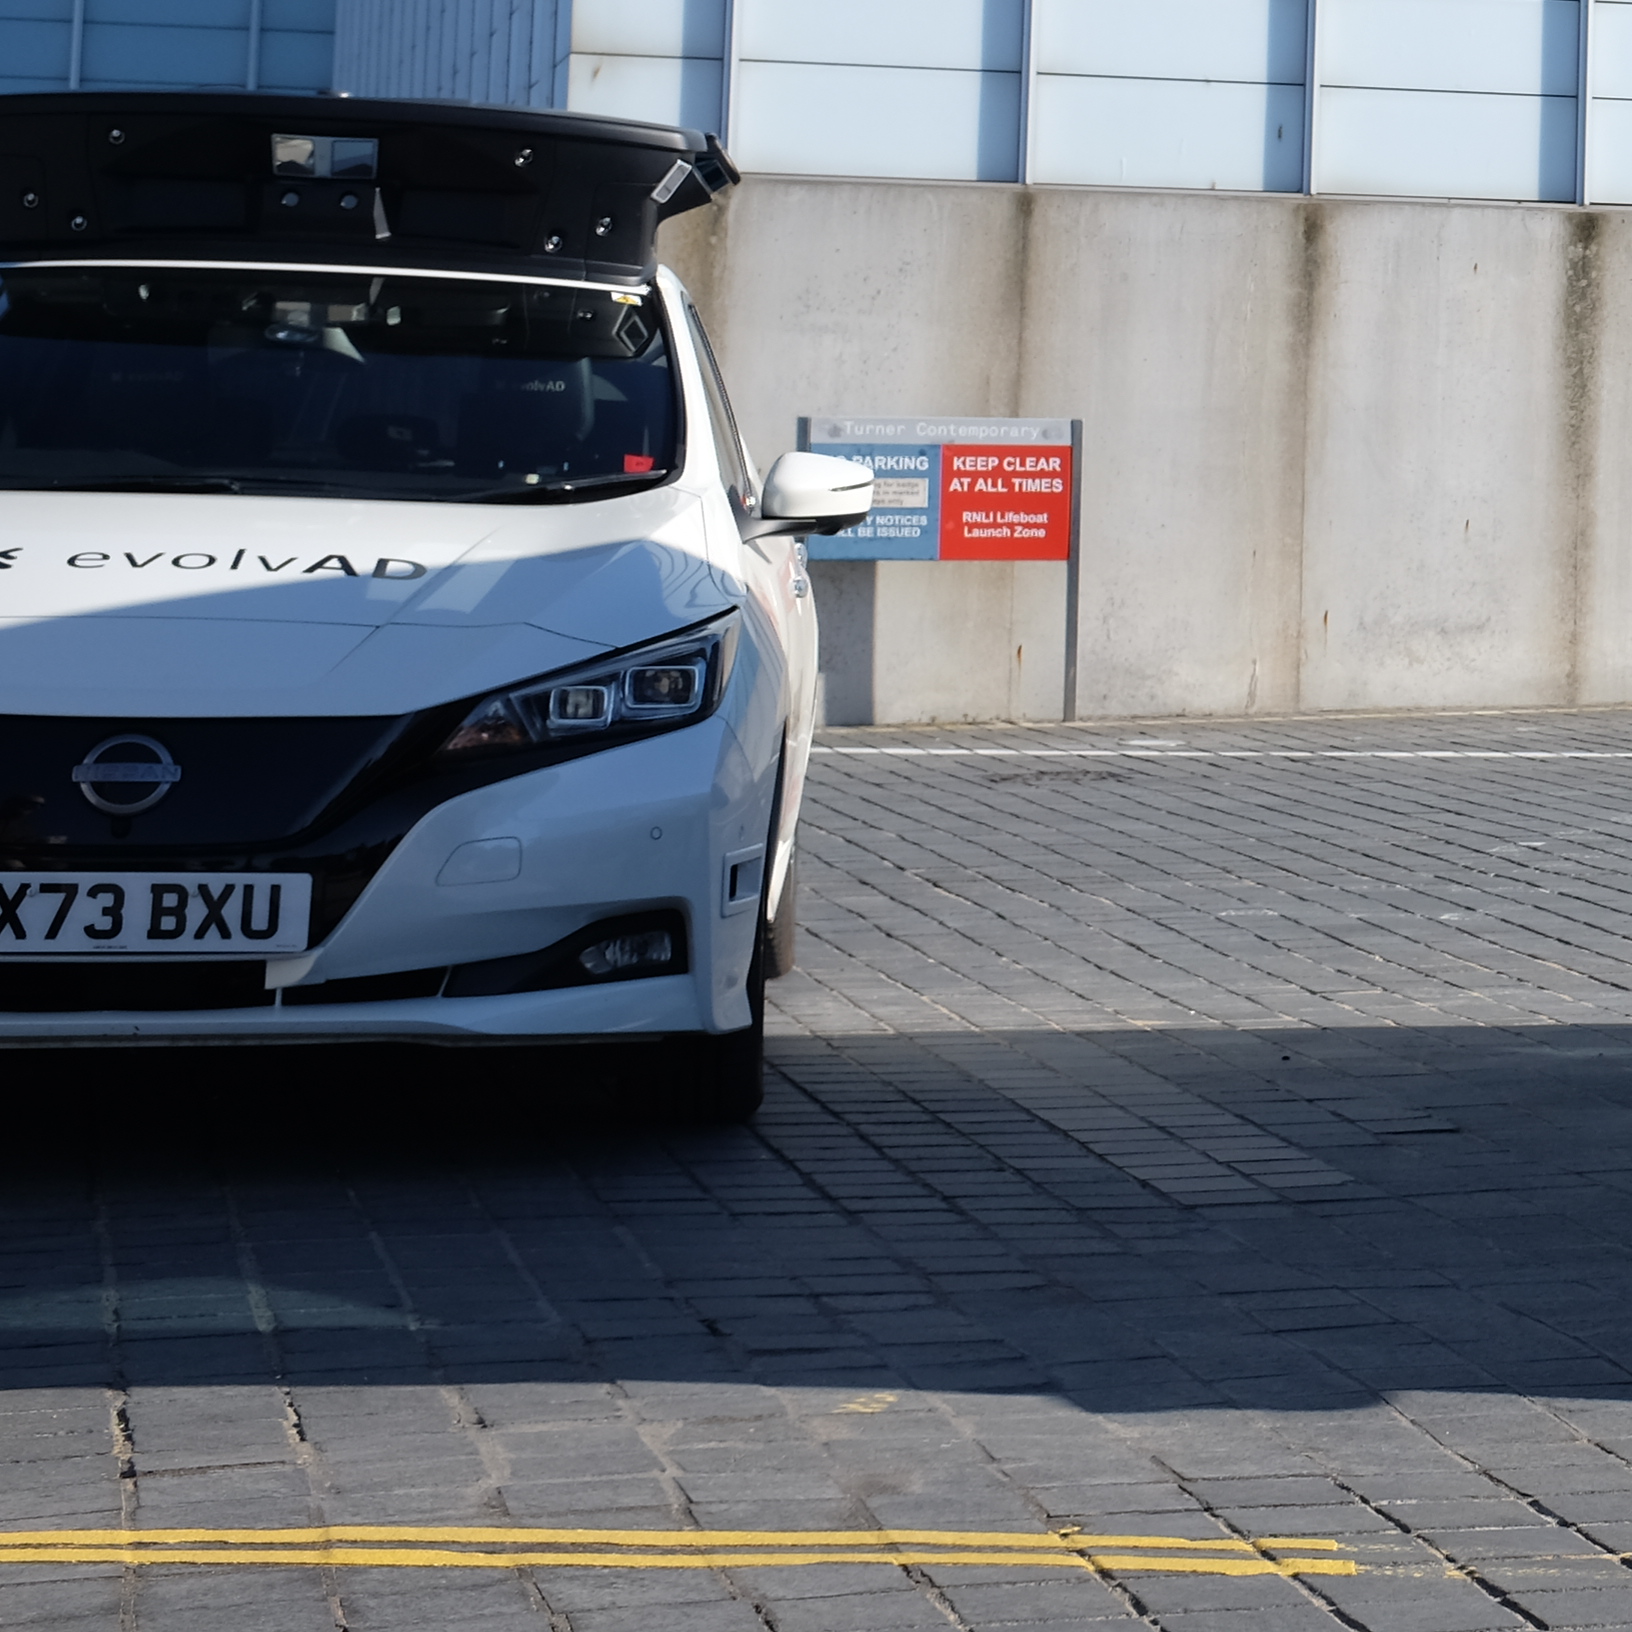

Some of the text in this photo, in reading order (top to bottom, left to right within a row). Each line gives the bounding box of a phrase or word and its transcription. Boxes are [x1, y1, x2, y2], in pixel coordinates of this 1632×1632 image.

[842, 421, 1041, 440] Turner Contemporary
[952, 456, 1062, 472] KEEP CLEAR
[949, 477, 1063, 493] AT ALL TIMES
[875, 515, 928, 526] NOTICES
[962, 511, 1048, 524] RNLI Lifeboat
[858, 527, 874, 537] BE
[877, 527, 921, 537] ISSUED
[963, 526, 1046, 539] Launch Zone
[66, 548, 427, 581] evolvAD
[147, 883, 281, 940] BXU
